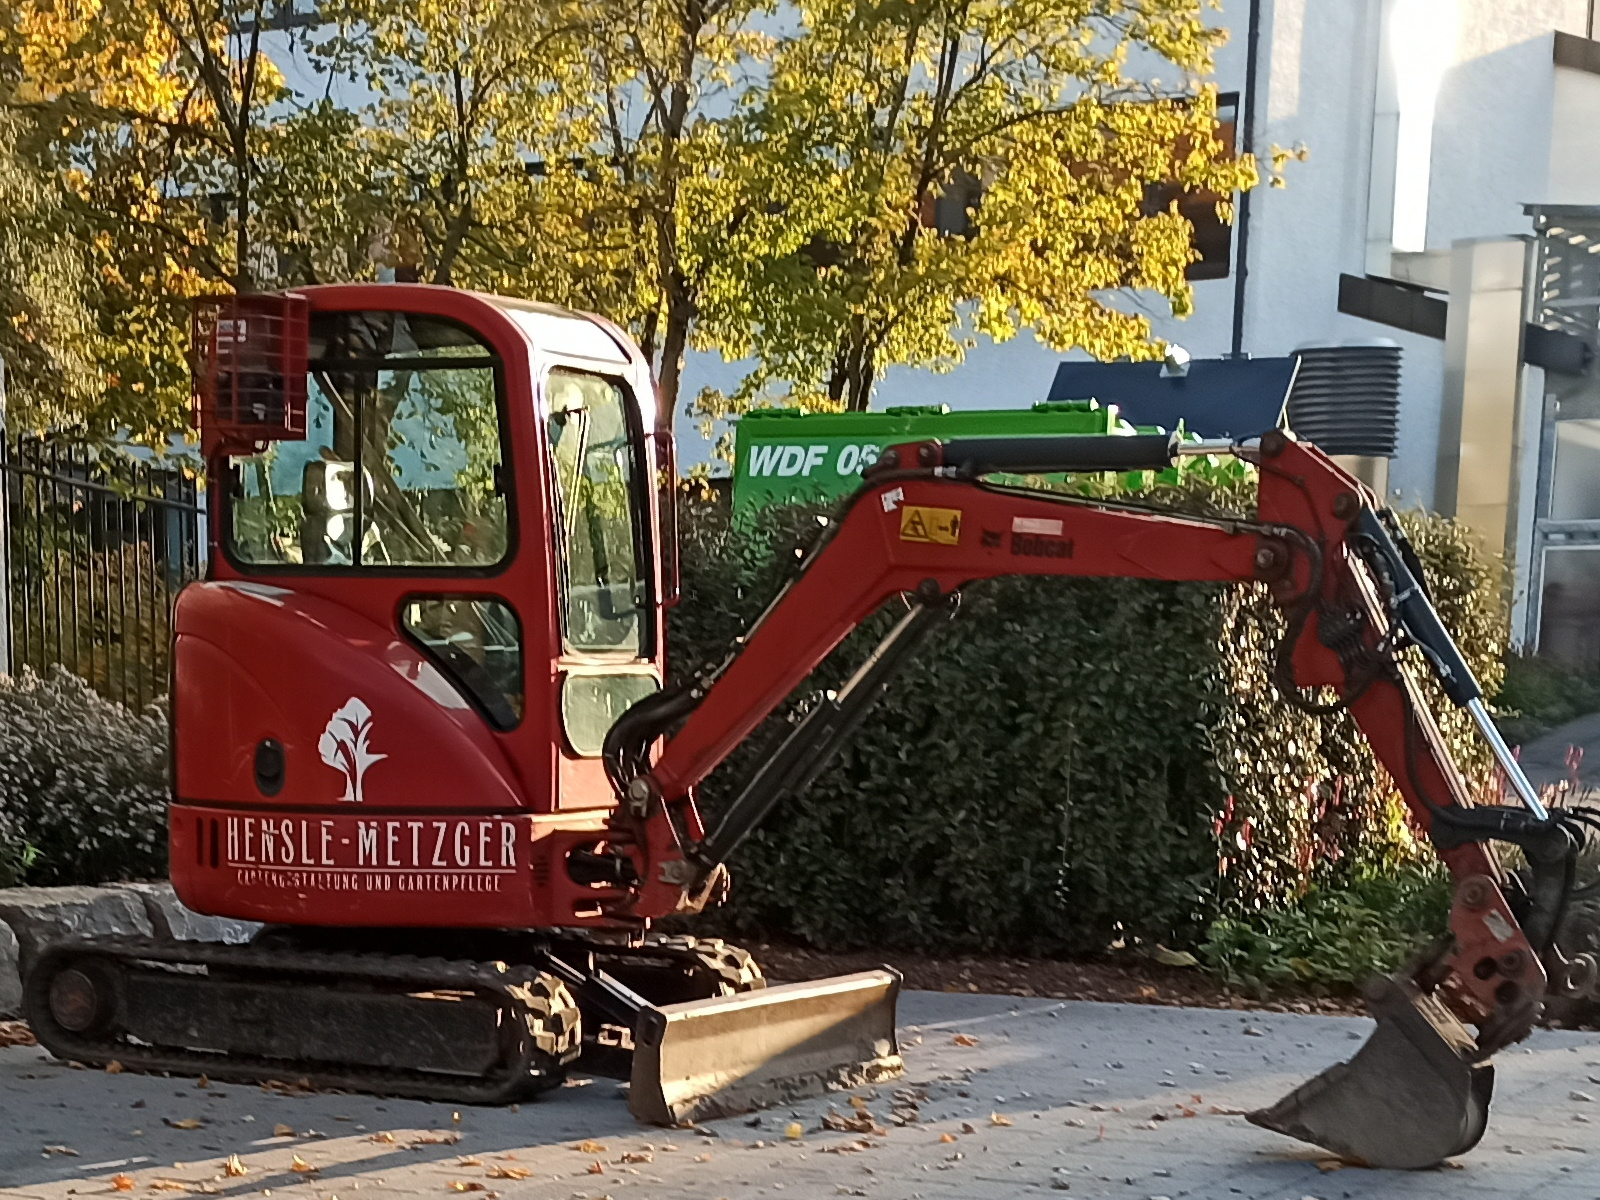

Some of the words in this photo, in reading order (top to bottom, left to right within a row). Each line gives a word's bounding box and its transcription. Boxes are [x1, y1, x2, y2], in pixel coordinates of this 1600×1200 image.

[749, 444, 829, 477] WDF
[1010, 533, 1074, 560] Bobcat
[227, 816, 517, 867] HENSLE-METZGER
[366, 874, 391, 891] UND
[398, 874, 502, 893] GARTENPFLEGE
